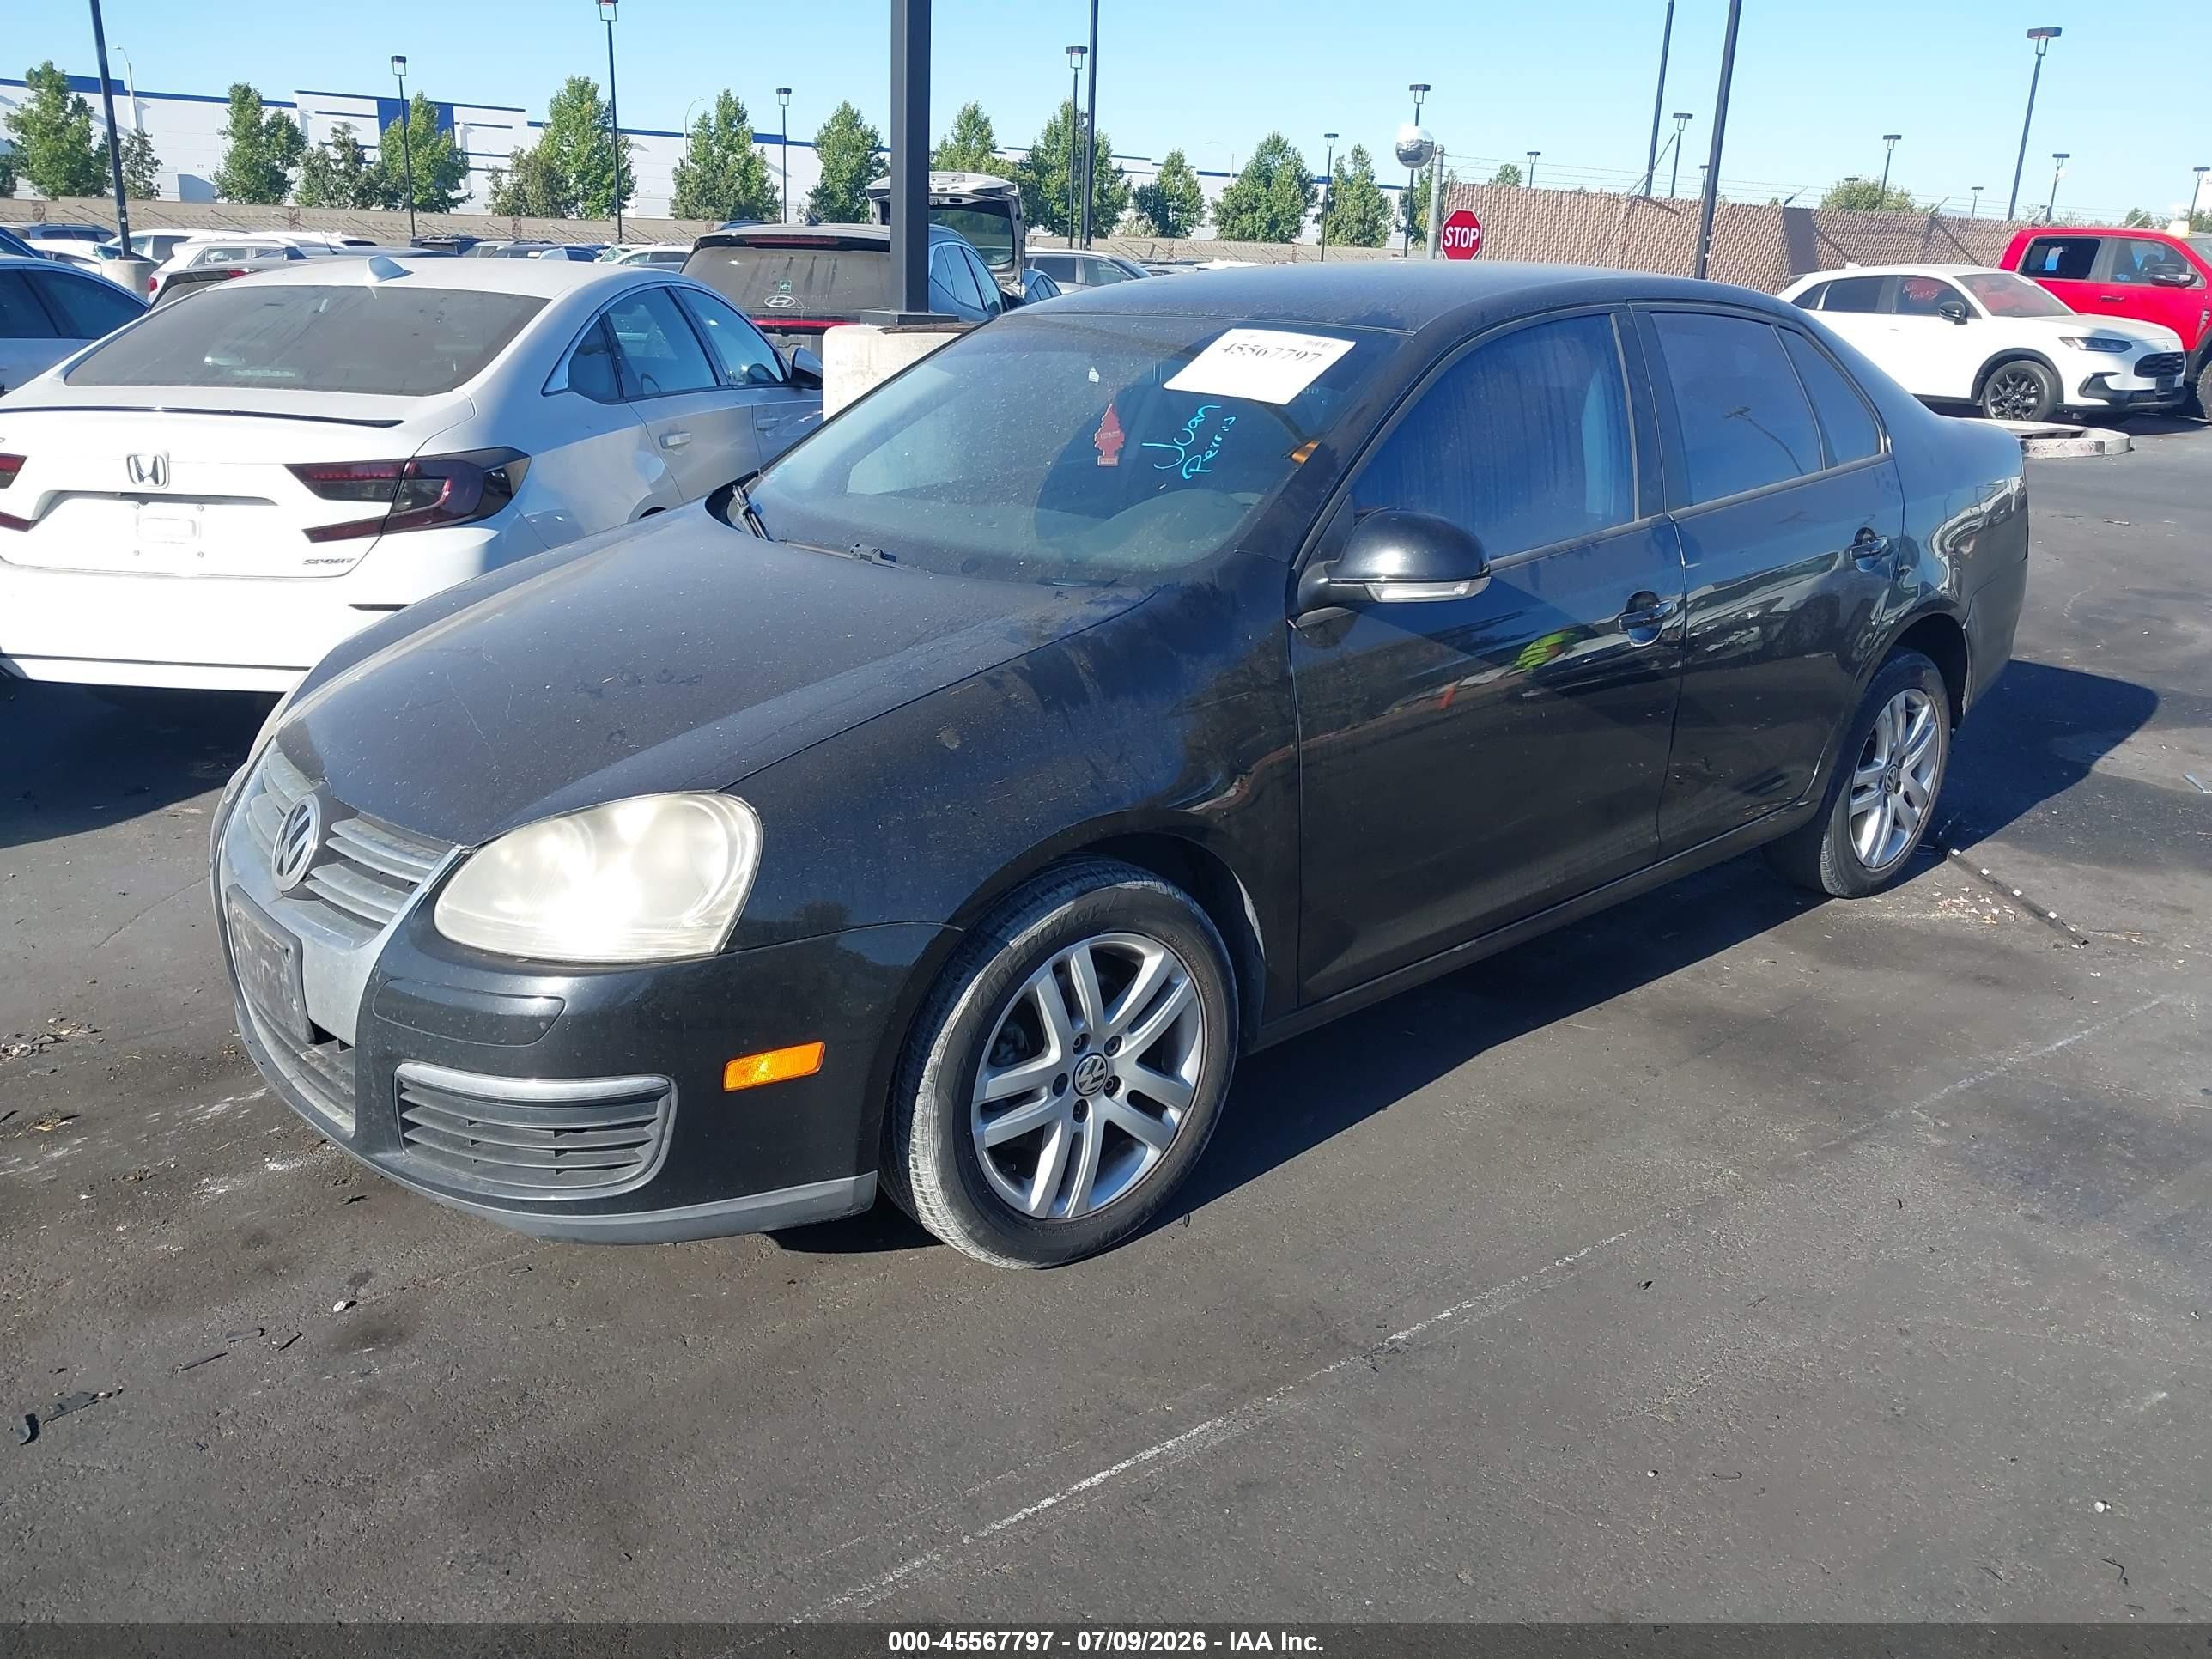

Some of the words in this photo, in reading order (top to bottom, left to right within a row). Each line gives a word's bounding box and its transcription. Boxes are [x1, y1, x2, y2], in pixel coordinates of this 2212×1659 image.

[1443, 226, 1480, 248] STOP
[1221, 343, 1323, 363] 45567797
[1141, 404, 1222, 470] Juan
